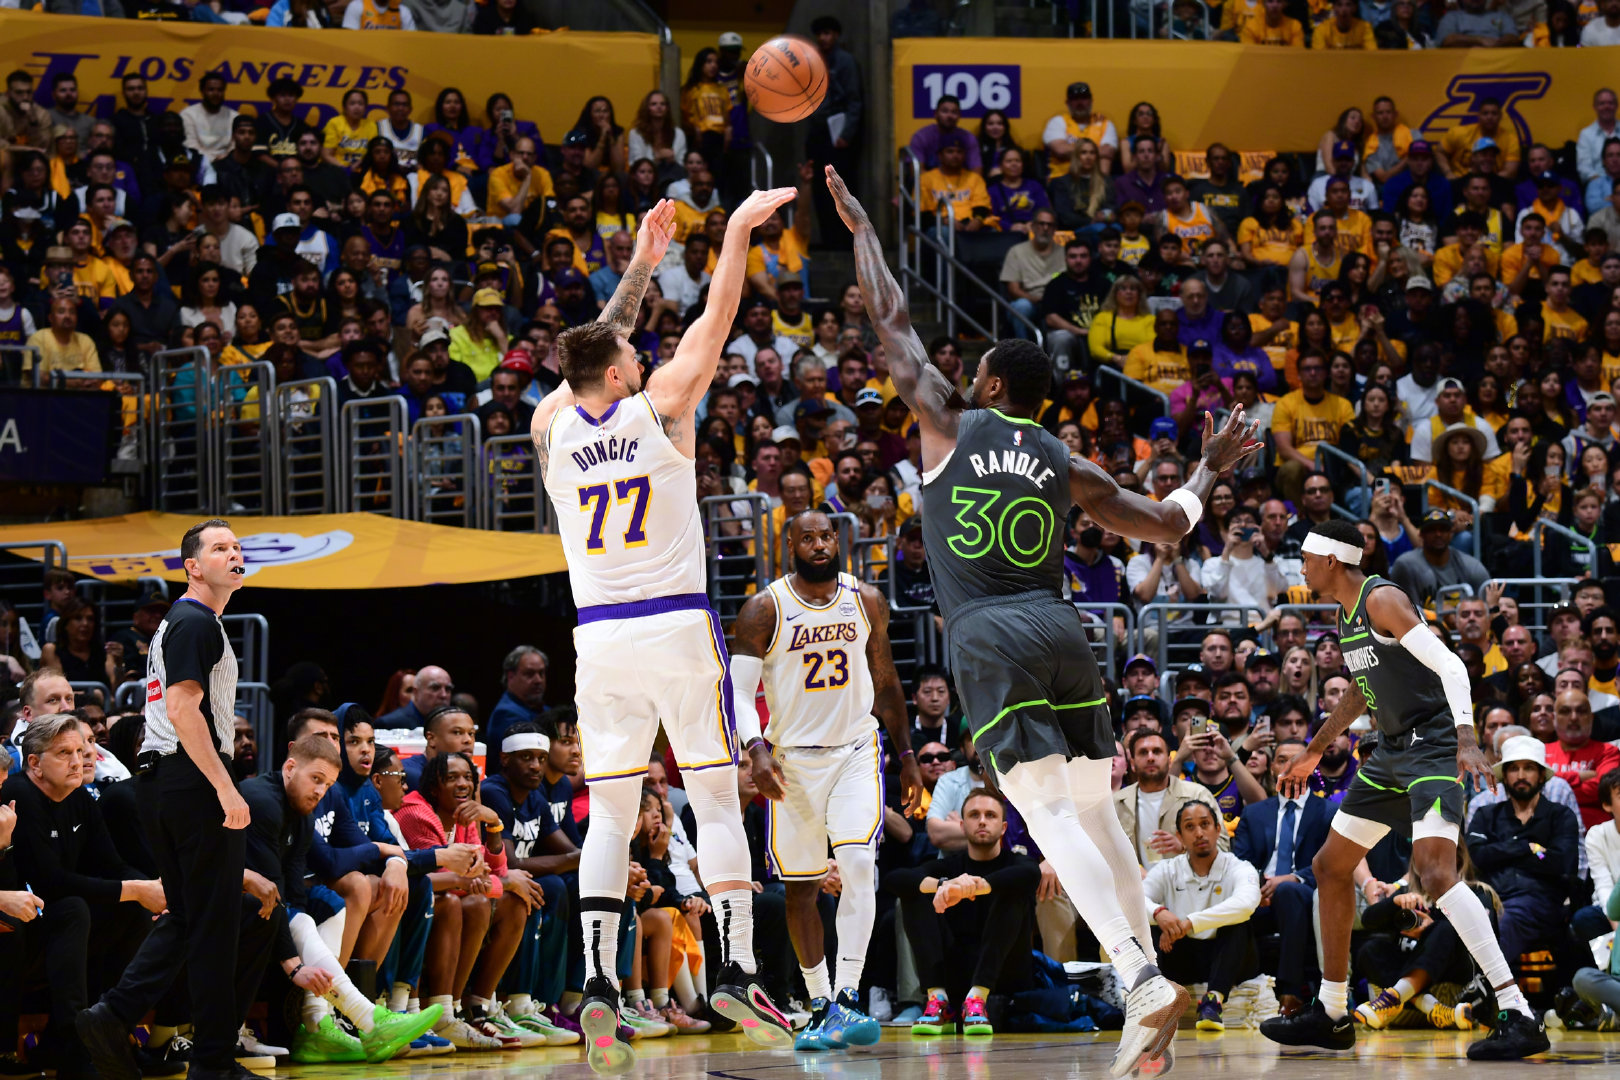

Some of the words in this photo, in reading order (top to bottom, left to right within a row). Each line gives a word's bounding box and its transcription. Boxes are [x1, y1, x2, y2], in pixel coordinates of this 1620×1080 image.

[110, 55, 194, 82] LOS
[205, 60, 409, 91] ANGELES
[923, 72, 1011, 111] 106
[571, 435, 640, 472] DONČIĆ
[969, 450, 1055, 489] RANDLE
[576, 473, 653, 556] 77
[947, 486, 1054, 568] 30
[786, 622, 858, 652] LAKERS
[803, 648, 850, 693] 23
[1355, 675, 1378, 710] 3
